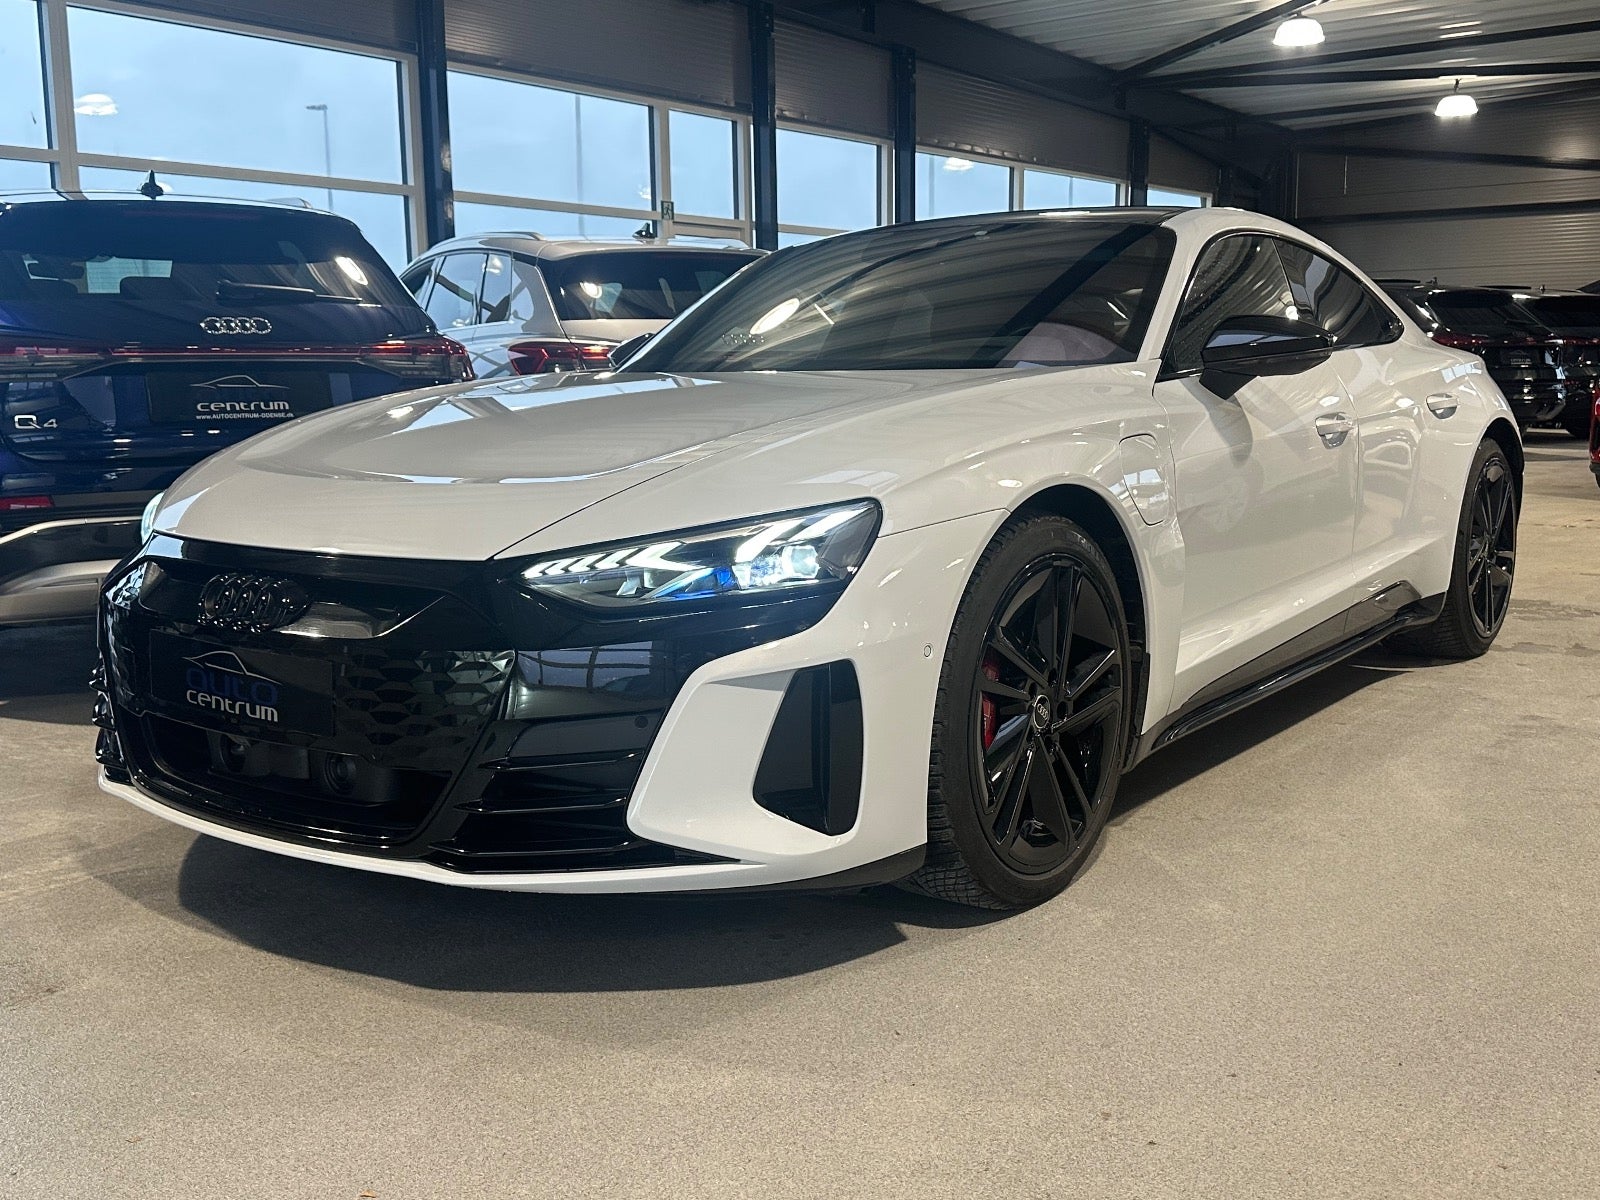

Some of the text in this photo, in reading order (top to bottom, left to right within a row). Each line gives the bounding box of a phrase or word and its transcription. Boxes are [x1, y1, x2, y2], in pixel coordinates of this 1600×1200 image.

[196, 401, 290, 412] centrum
[195, 412, 295, 420] www.AUTOCENTRUM-ODENSE.dk
[186, 689, 279, 723] centrum
